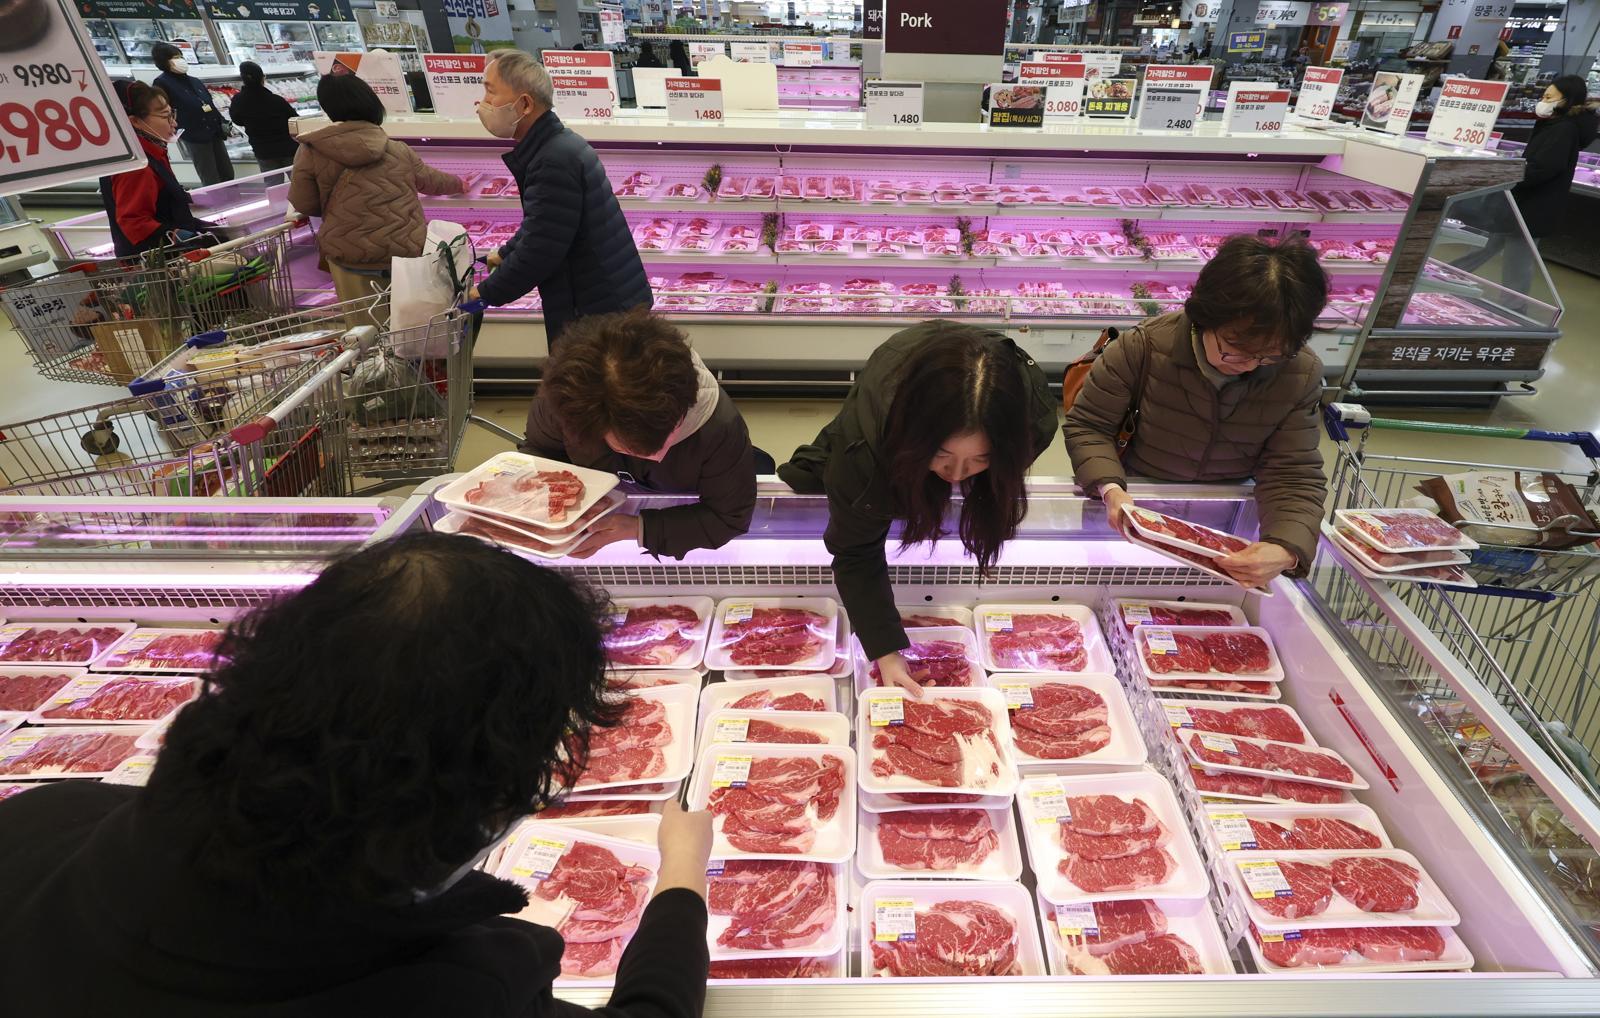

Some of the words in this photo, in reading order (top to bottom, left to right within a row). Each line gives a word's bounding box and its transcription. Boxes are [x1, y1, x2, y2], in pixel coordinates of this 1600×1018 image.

[900, 12, 933, 28] Pork
[427, 59, 461, 70] 가격할인
[463, 61, 476, 69] 행사
[545, 55, 574, 64] 가격할인
[13, 63, 72, 88] 9,980
[1022, 66, 1050, 75] 가격할인
[1148, 69, 1176, 78] 가격할인
[432, 75, 462, 84] 선진포크
[1444, 83, 1470, 94] 가격할인
[584, 107, 612, 118] 2,380
[1046, 101, 1078, 113] 3,080
[1311, 104, 1330, 117] 2,280
[695, 109, 722, 120] 1,480
[893, 114, 920, 124] 1,480
[1166, 119, 1192, 129] 2,480
[1255, 121, 1281, 131] 1,680
[0, 96, 111, 164] ,980
[1453, 127, 1486, 145] 2,380
[1391, 346, 1432, 361] 원칙을
[1434, 346, 1473, 361] 지키는
[1476, 346, 1516, 361] 목우촌
